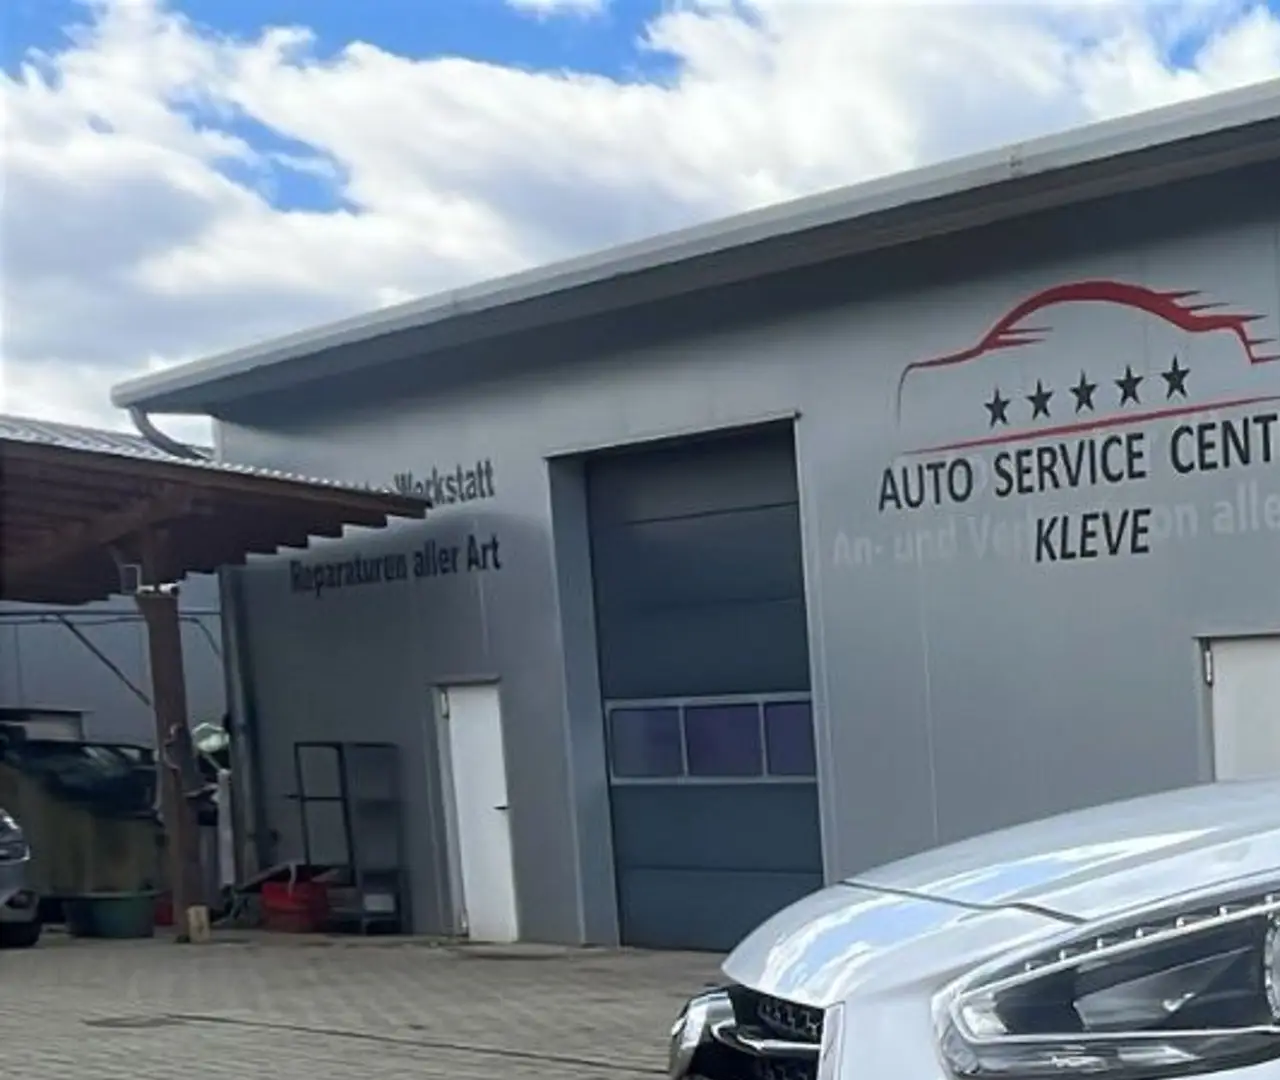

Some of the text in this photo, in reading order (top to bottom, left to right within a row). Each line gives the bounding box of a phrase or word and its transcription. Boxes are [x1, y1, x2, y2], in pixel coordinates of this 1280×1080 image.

[878, 457, 975, 512] AUTO
[993, 431, 1148, 498] SERVICE
[414, 539, 460, 576] aller
[467, 534, 502, 571] Art
[1034, 507, 1152, 563] KLEVE
